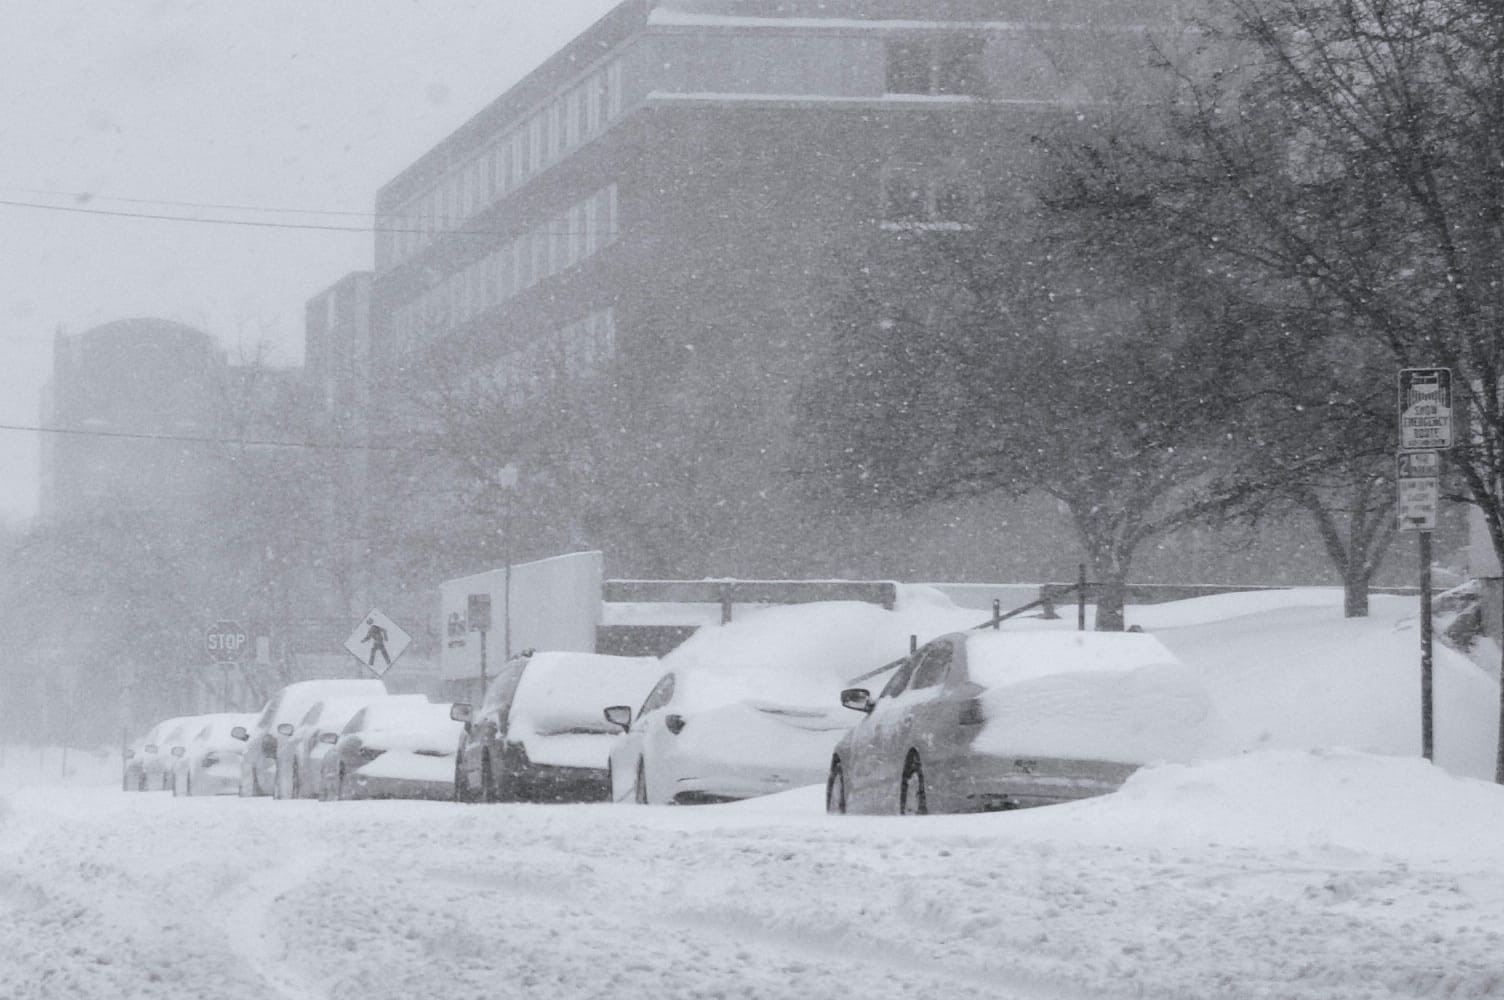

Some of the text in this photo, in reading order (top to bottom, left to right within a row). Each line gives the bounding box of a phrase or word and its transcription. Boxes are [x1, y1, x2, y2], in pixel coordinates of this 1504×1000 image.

[1414, 405, 1437, 416] SNOW
[1404, 416, 1448, 427] EMERGENCY
[1413, 428, 1440, 439] ROUTE
[1399, 456, 1408, 477] 2
[208, 633, 245, 650] STOP
